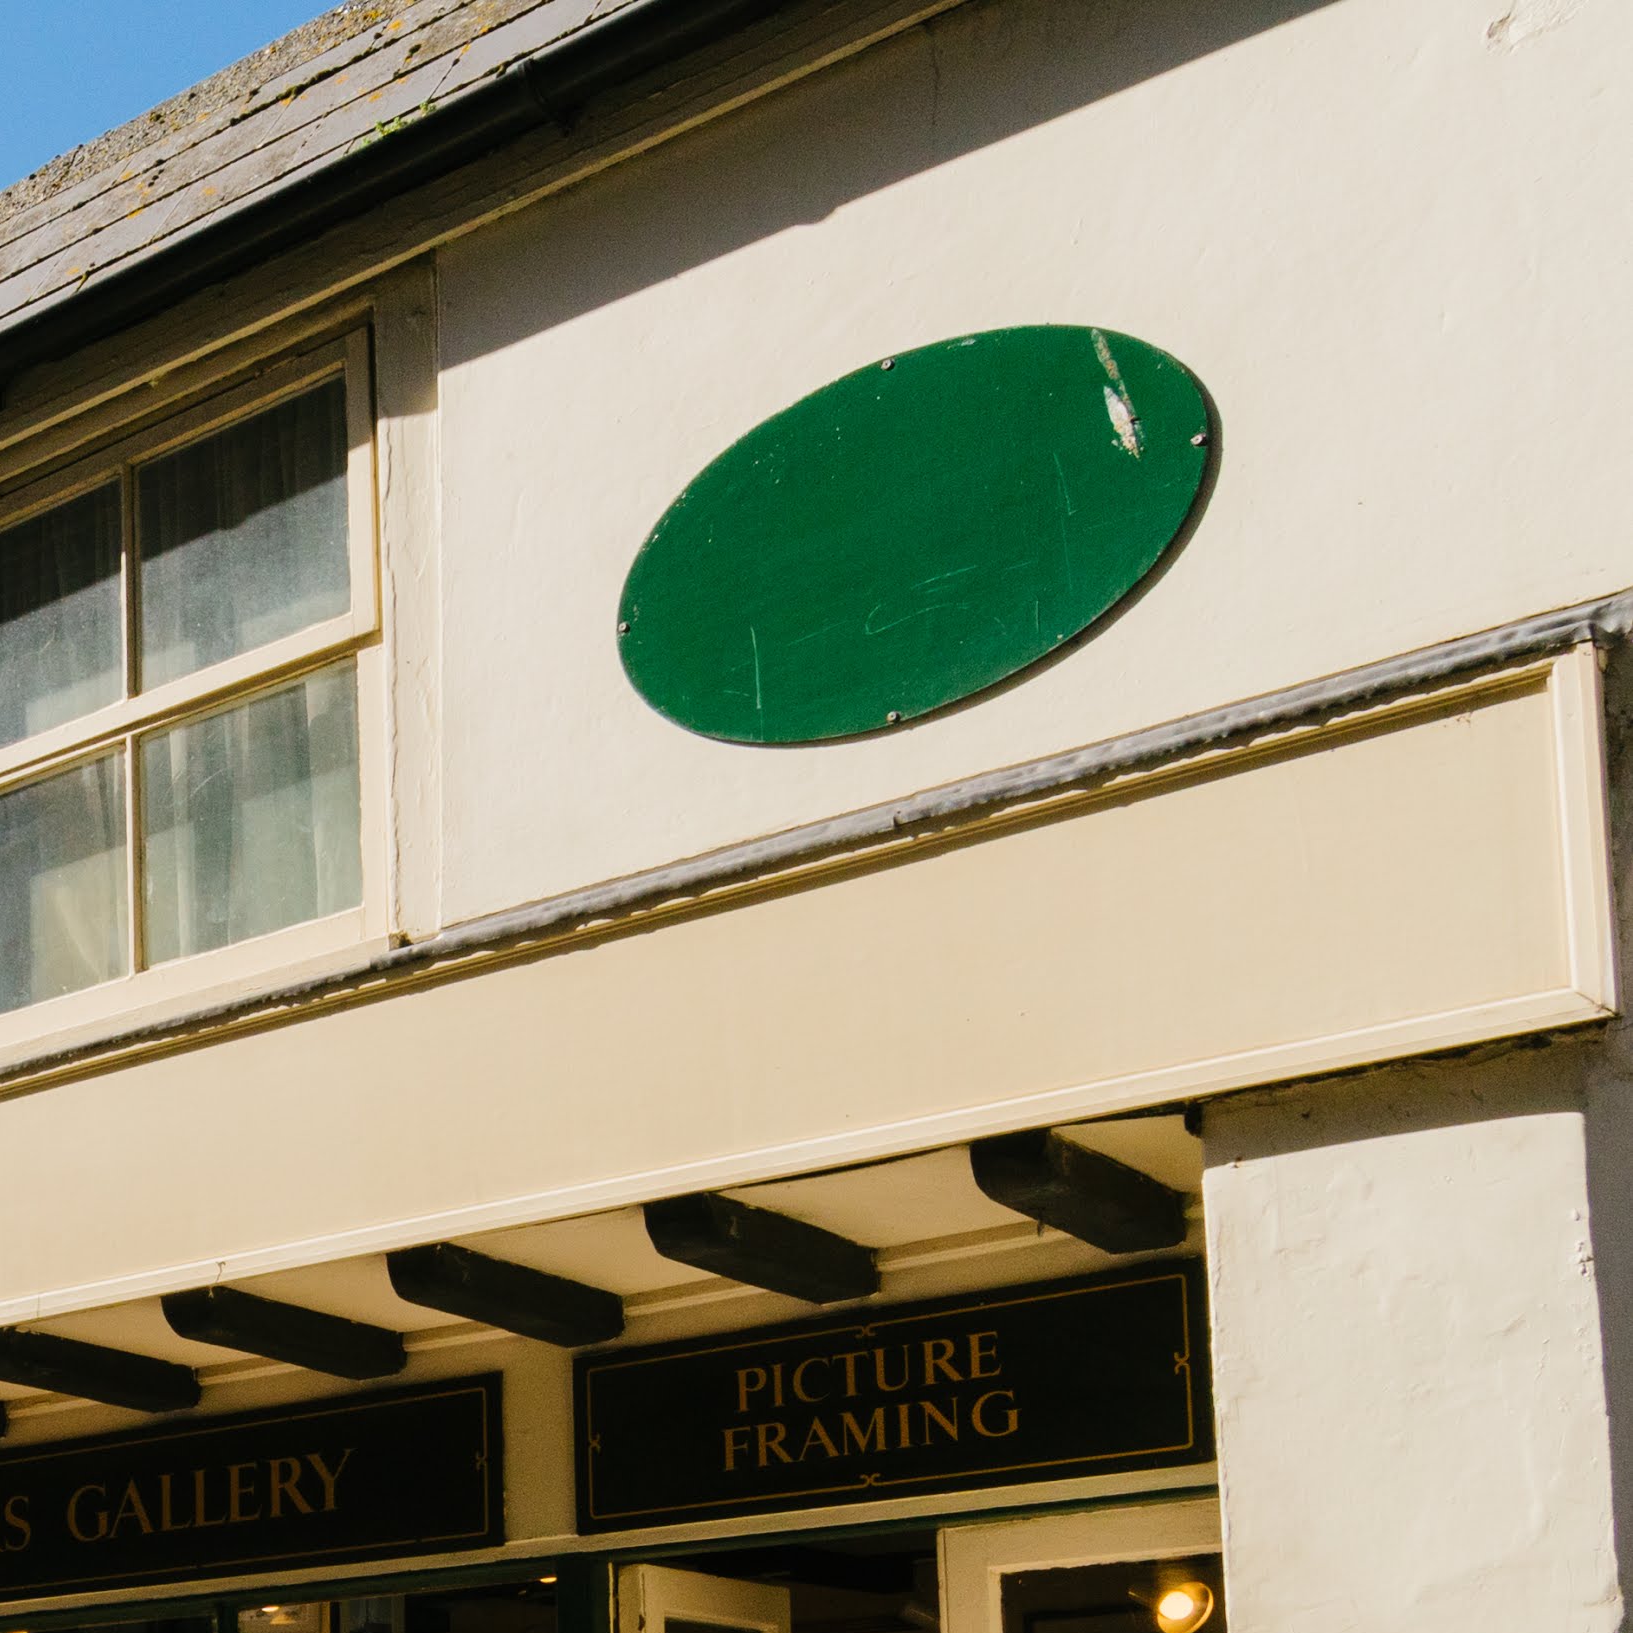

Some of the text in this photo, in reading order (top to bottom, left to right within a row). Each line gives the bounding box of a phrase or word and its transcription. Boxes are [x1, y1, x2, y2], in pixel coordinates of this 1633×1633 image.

[736, 1331, 1003, 1413] PICTURE
[722, 1389, 1022, 1472] FRAMING
[66, 1447, 356, 1544] GALLERY
